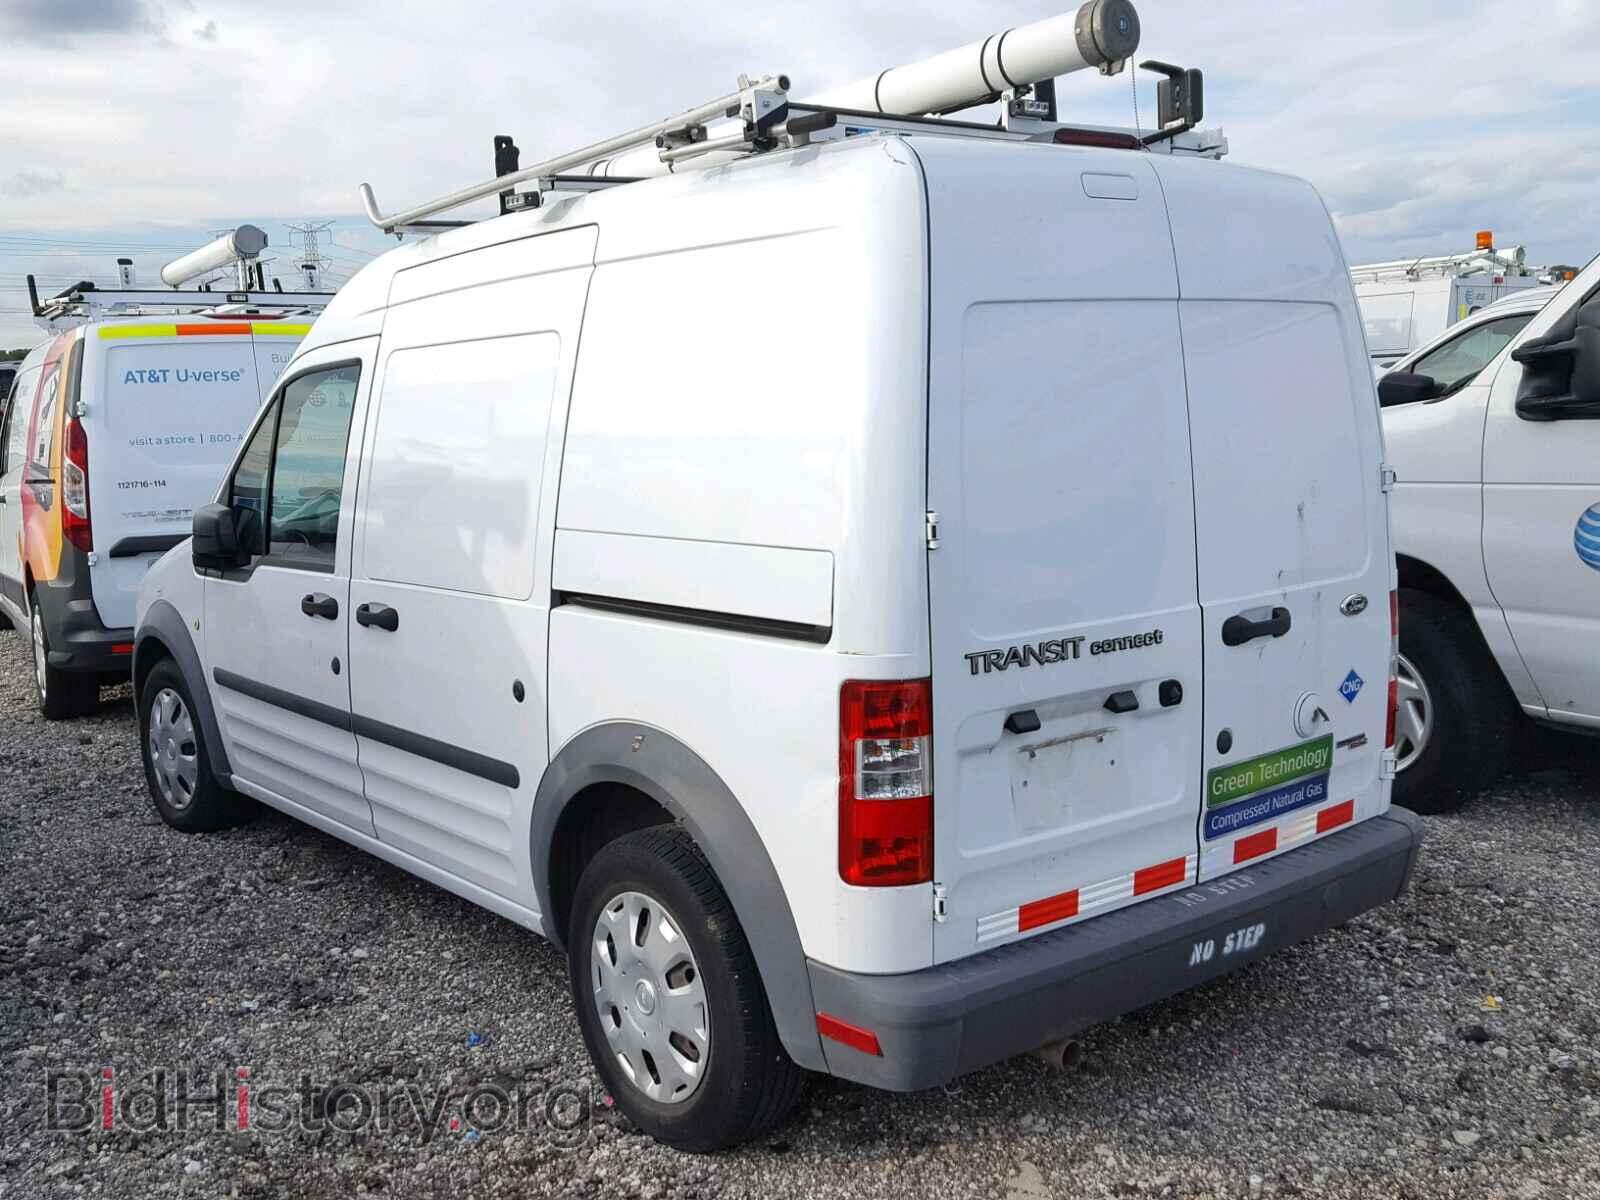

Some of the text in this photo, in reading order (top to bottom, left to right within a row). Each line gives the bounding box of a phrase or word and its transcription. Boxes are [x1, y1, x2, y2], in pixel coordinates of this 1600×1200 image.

[124, 369, 170, 384] AT&T
[129, 436, 154, 446] visit
[155, 437, 162, 445] a
[164, 435, 195, 445] store
[964, 628, 1165, 675] TRANSIT connect
[1342, 678, 1361, 695] CNG
[1212, 747, 1329, 795] Green Technology
[1211, 783, 1323, 831] Compressed Natural Gas
[1173, 874, 1256, 907] NO STEP
[1188, 922, 1267, 967] NO STEP
